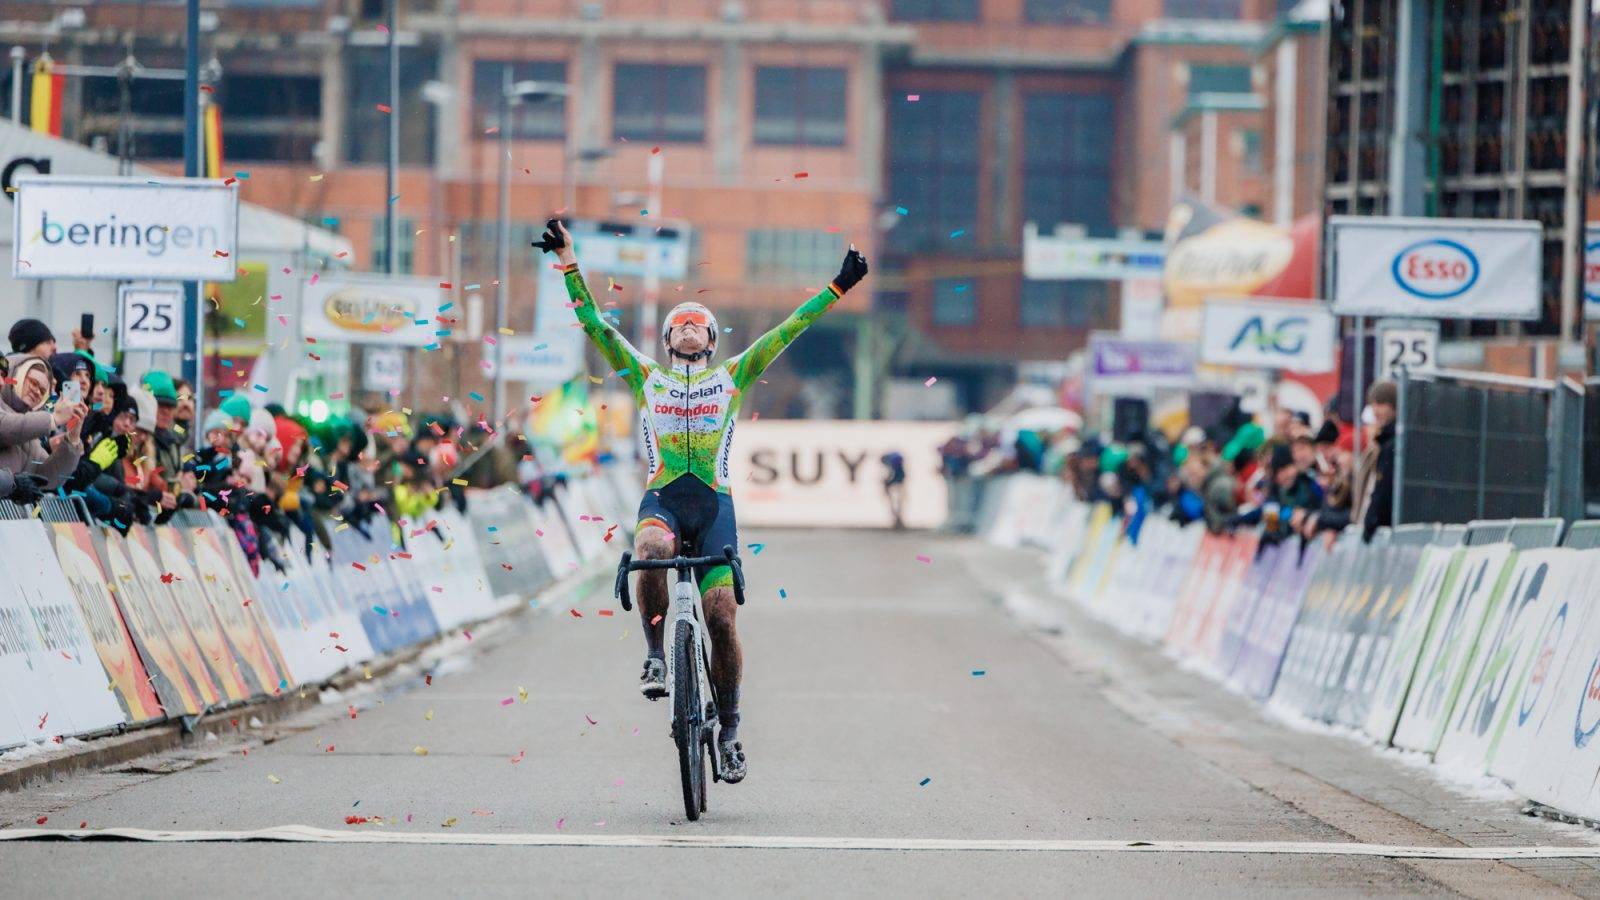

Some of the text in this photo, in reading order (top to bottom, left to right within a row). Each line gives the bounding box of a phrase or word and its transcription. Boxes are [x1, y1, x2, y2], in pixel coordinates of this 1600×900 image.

[41, 210, 218, 256] beringen
[1407, 254, 1467, 281] Esso
[129, 303, 172, 331] 25
[1228, 315, 1308, 355] AG
[1389, 340, 1428, 367] 25
[670, 384, 723, 400] crelan
[655, 402, 719, 417] corendon
[722, 418, 735, 478] FRISTADS
